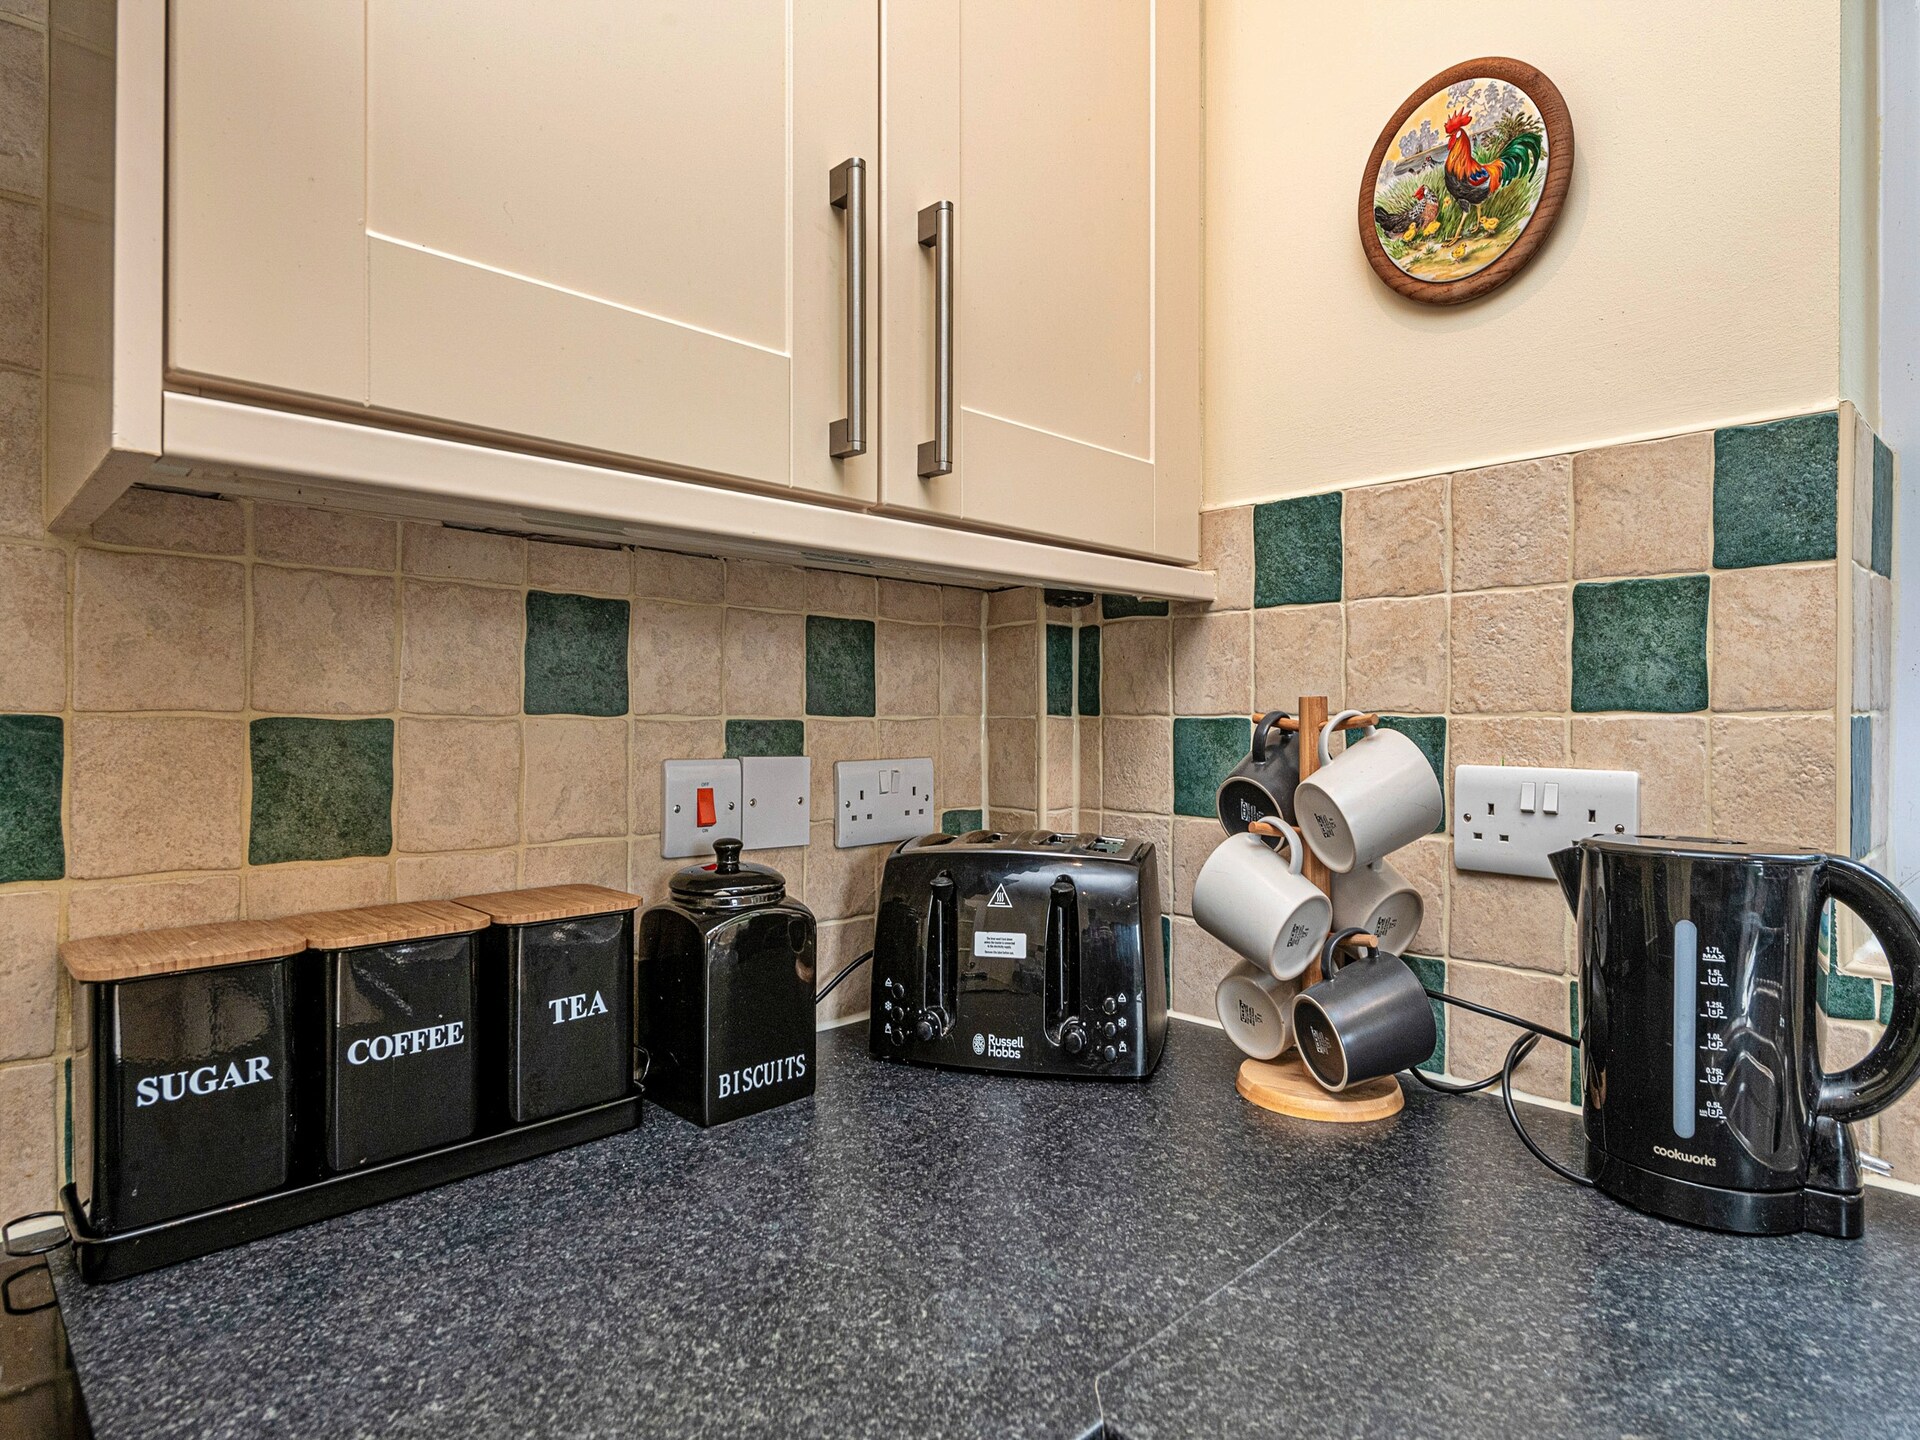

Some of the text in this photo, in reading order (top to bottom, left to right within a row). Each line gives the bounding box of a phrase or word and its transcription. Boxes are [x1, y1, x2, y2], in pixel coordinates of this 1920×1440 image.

[1705, 946, 1722, 954] 1.7L
[1707, 968, 1722, 976] 1.5L
[548, 990, 608, 1025] TEA
[1705, 1001, 1725, 1009] 1.25L
[347, 1021, 465, 1065] COFFEE
[988, 1033, 1024, 1049] Russell
[1707, 1033, 1722, 1041] 1.0L
[988, 1045, 1021, 1059] Hobbs
[718, 1053, 806, 1099] BISCUITS
[1705, 1066, 1724, 1076] 0.75L
[136, 1056, 273, 1107] SUGAR
[1706, 1101, 1723, 1109] 0.5L
[1653, 1145, 1717, 1167] cookworks
